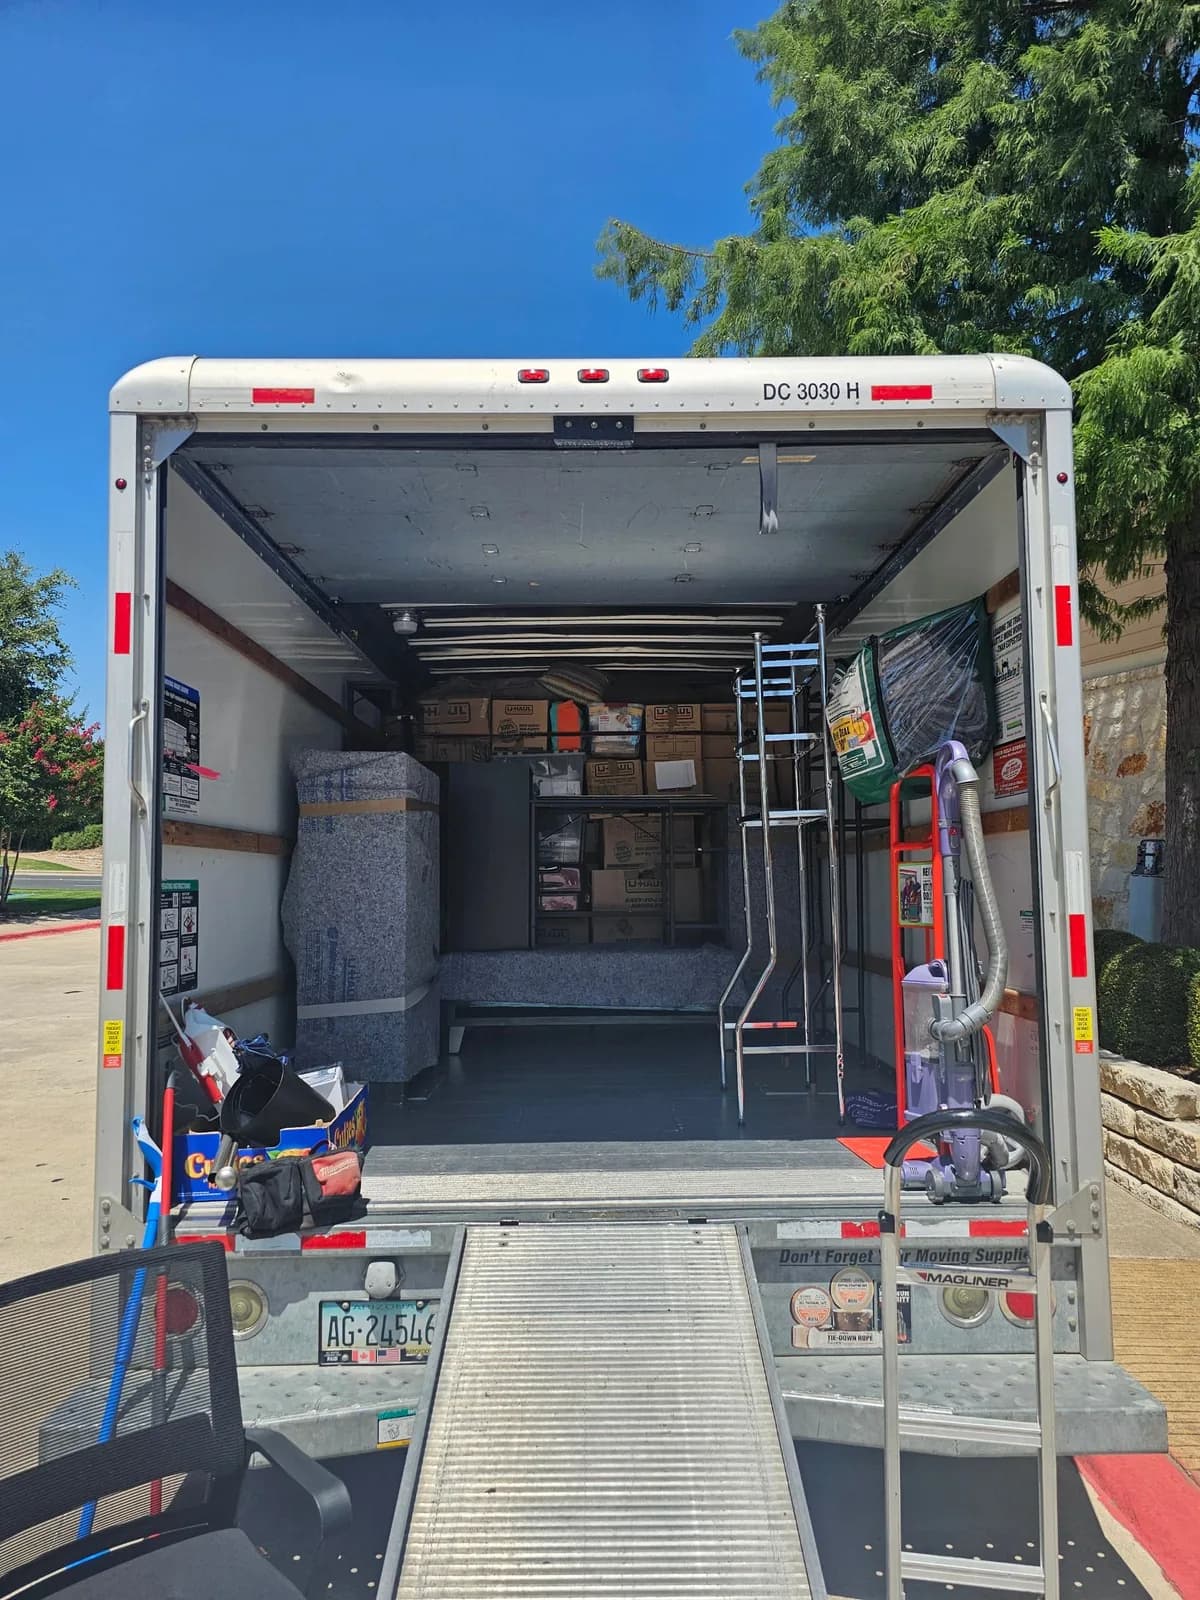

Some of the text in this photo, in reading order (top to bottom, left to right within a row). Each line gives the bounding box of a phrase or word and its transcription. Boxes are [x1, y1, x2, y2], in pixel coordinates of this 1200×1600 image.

[763, 382, 859, 400] DC 3030 H
[656, 706, 691, 715] U-UL
[597, 763, 632, 773] U-UL
[779, 1248, 820, 1263] Don't
[825, 1248, 874, 1266] Forget
[916, 1247, 970, 1264] Moving
[975, 1247, 1031, 1265] Suppli
[927, 1273, 1009, 1287] MAGLINER
[827, 1334, 857, 1342] TIE-DOWN
